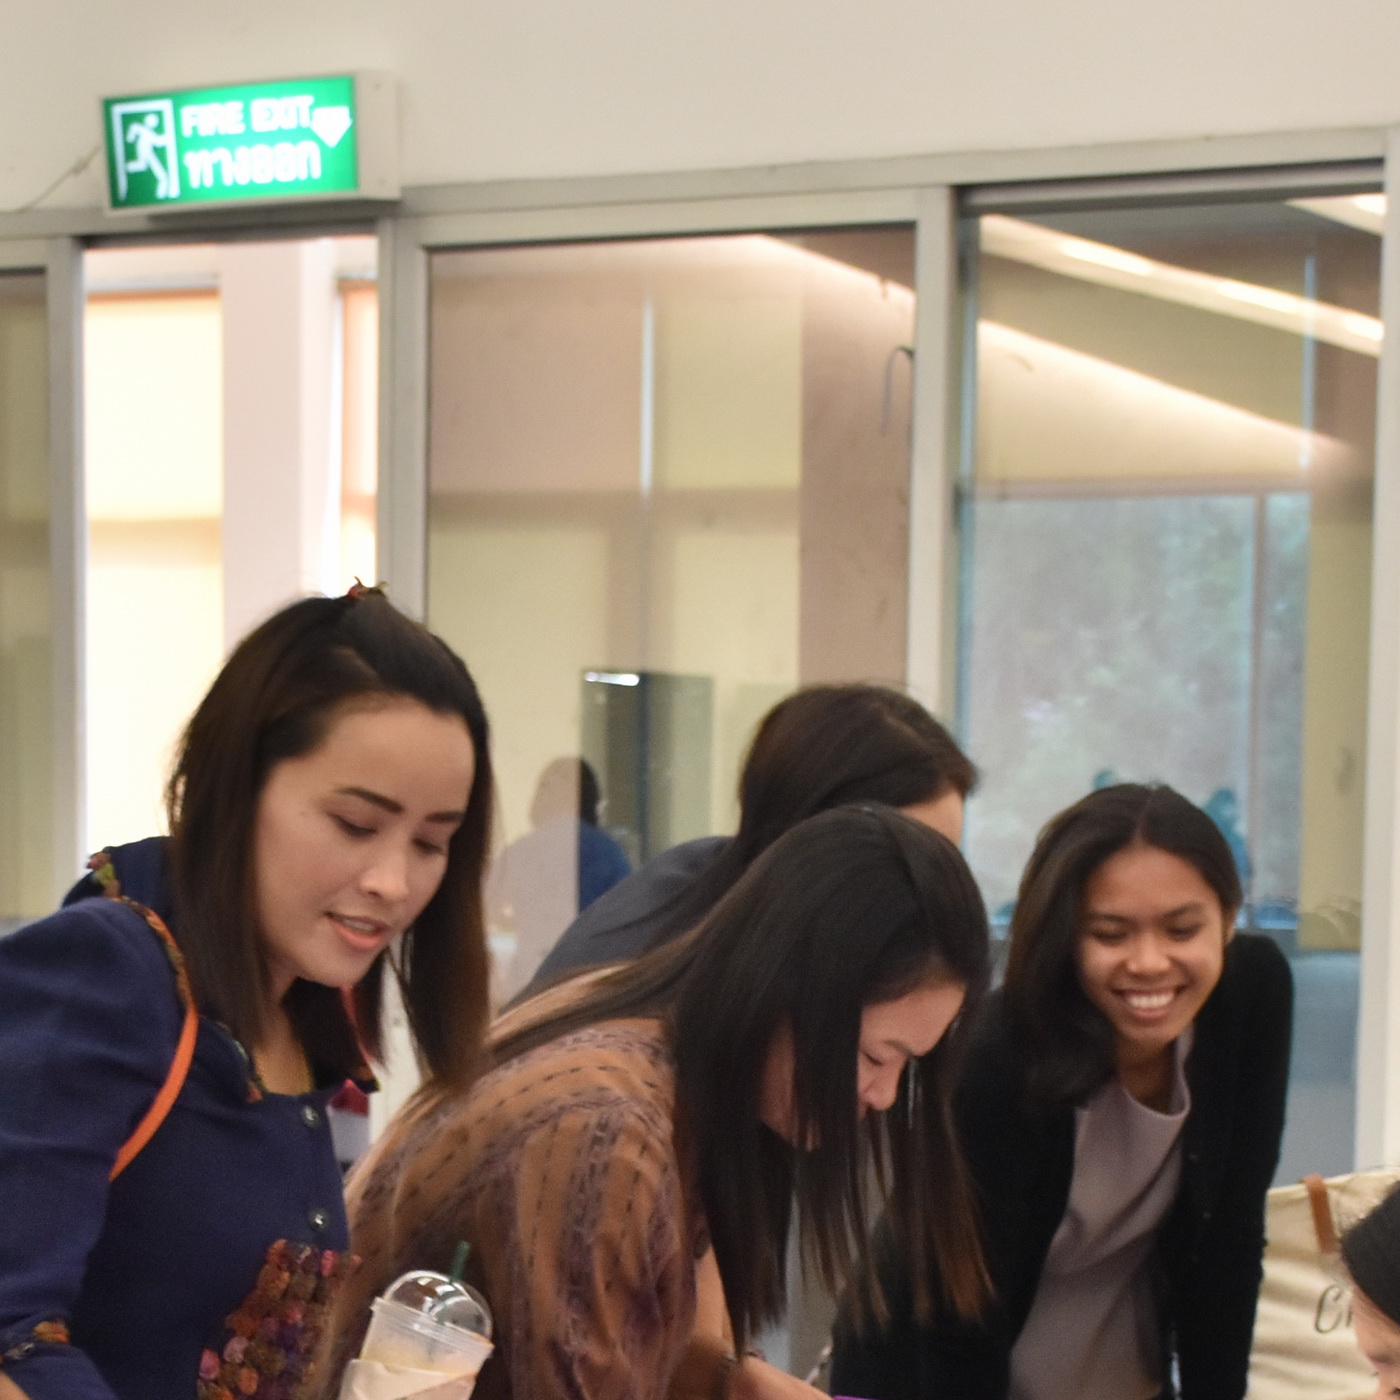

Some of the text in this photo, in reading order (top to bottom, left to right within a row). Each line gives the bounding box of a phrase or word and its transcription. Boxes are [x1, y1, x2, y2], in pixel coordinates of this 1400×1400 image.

[180, 94, 315, 138] FIRE EXIT
[184, 140, 323, 189] ทางออก
